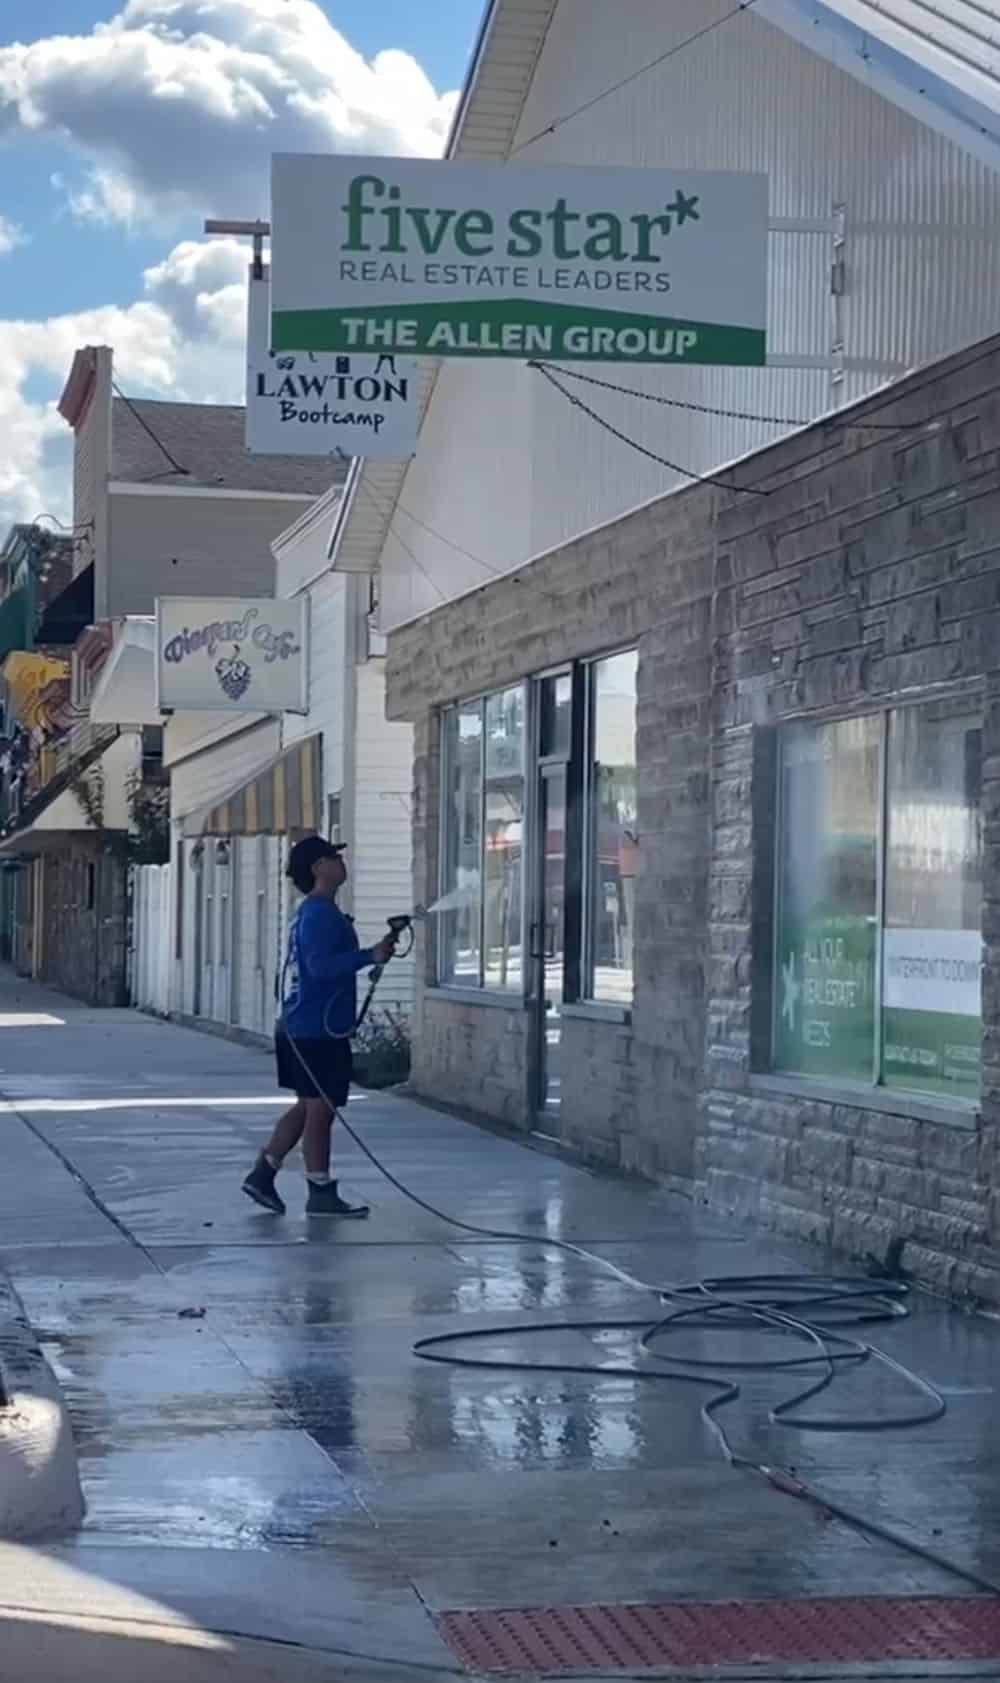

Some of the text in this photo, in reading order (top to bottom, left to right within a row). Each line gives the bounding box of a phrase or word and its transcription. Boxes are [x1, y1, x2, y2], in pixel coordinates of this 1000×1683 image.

[340, 175, 493, 256] five
[340, 260, 671, 293] REAL ESTATE LEADERS
[341, 317, 697, 356] THE ALLEN GROUP
[256, 372, 408, 401] LAWTON
[279, 400, 385, 434] Bootcamp
